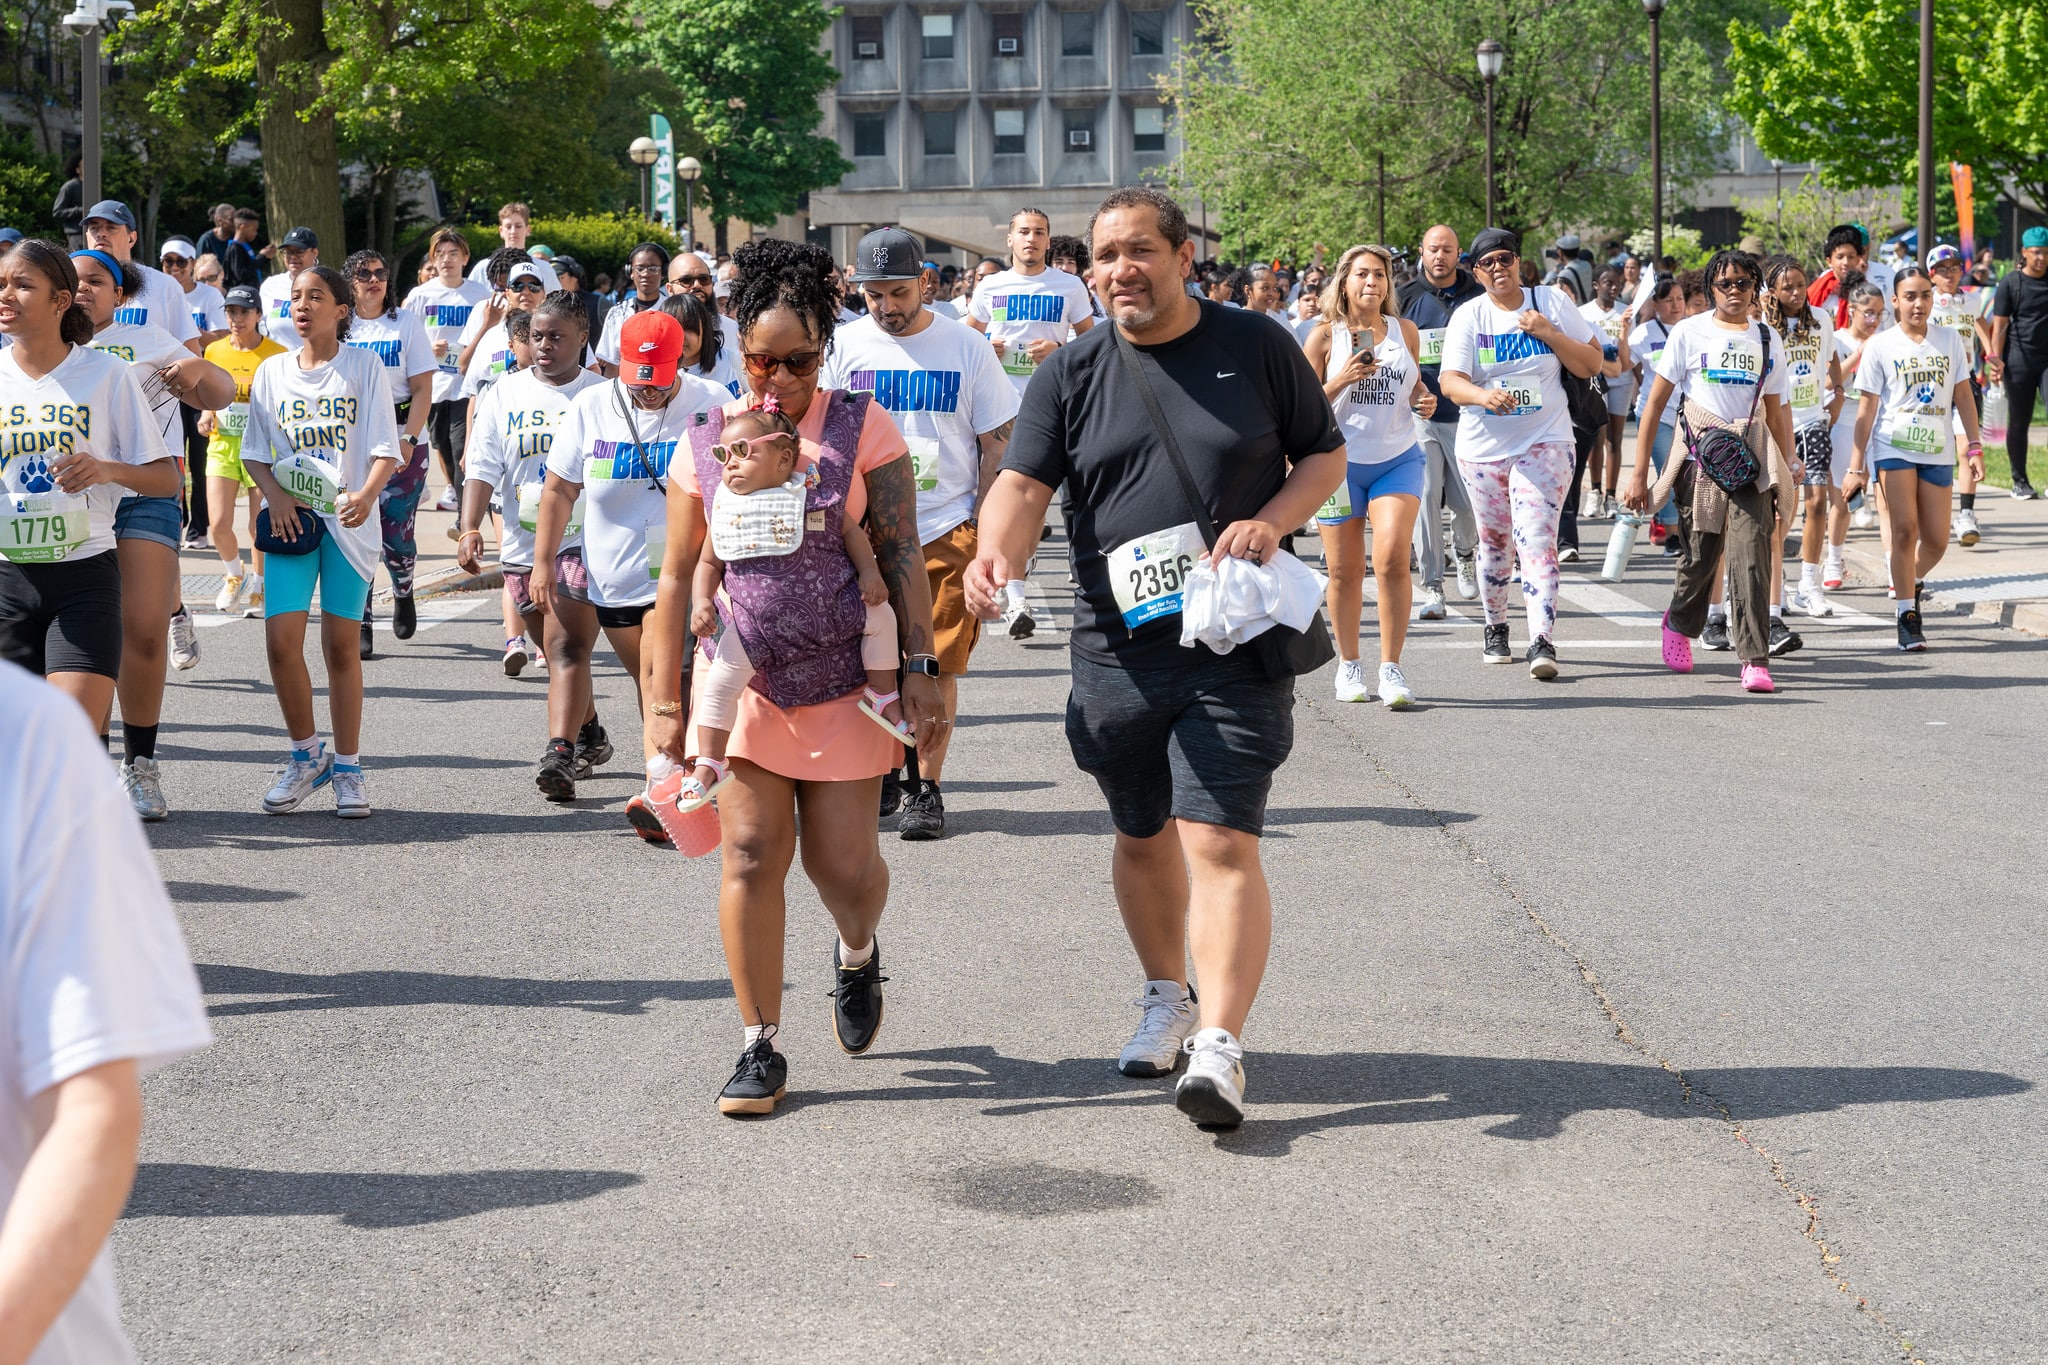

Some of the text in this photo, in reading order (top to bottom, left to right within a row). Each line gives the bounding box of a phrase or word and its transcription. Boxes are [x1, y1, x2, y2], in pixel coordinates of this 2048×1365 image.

[437, 304, 473, 327] BRO
[1007, 294, 1065, 323] BRONX
[1784, 336, 1799, 349] .S.
[1721, 351, 1755, 371] 2195
[1893, 356, 1924, 382] M.S.
[851, 370, 876, 391] RUN
[1358, 378, 1391, 391] BRONX
[1380, 365, 1408, 386] DOWN
[1903, 369, 1946, 397] LIONS
[875, 369, 962, 413] BRONX
[1350, 390, 1396, 406] RUNNERS
[1507, 389, 1531, 406] 96
[0, 402, 92, 441] .S. 363
[318, 395, 358, 427] 363
[506, 409, 551, 438] M.S.
[517, 432, 555, 460] LIO
[1906, 425, 1936, 444] 1024
[289, 469, 324, 498] 1045
[312, 499, 327, 512] 5K
[10, 515, 67, 545] 1779
[1128, 553, 1195, 604] 2356
